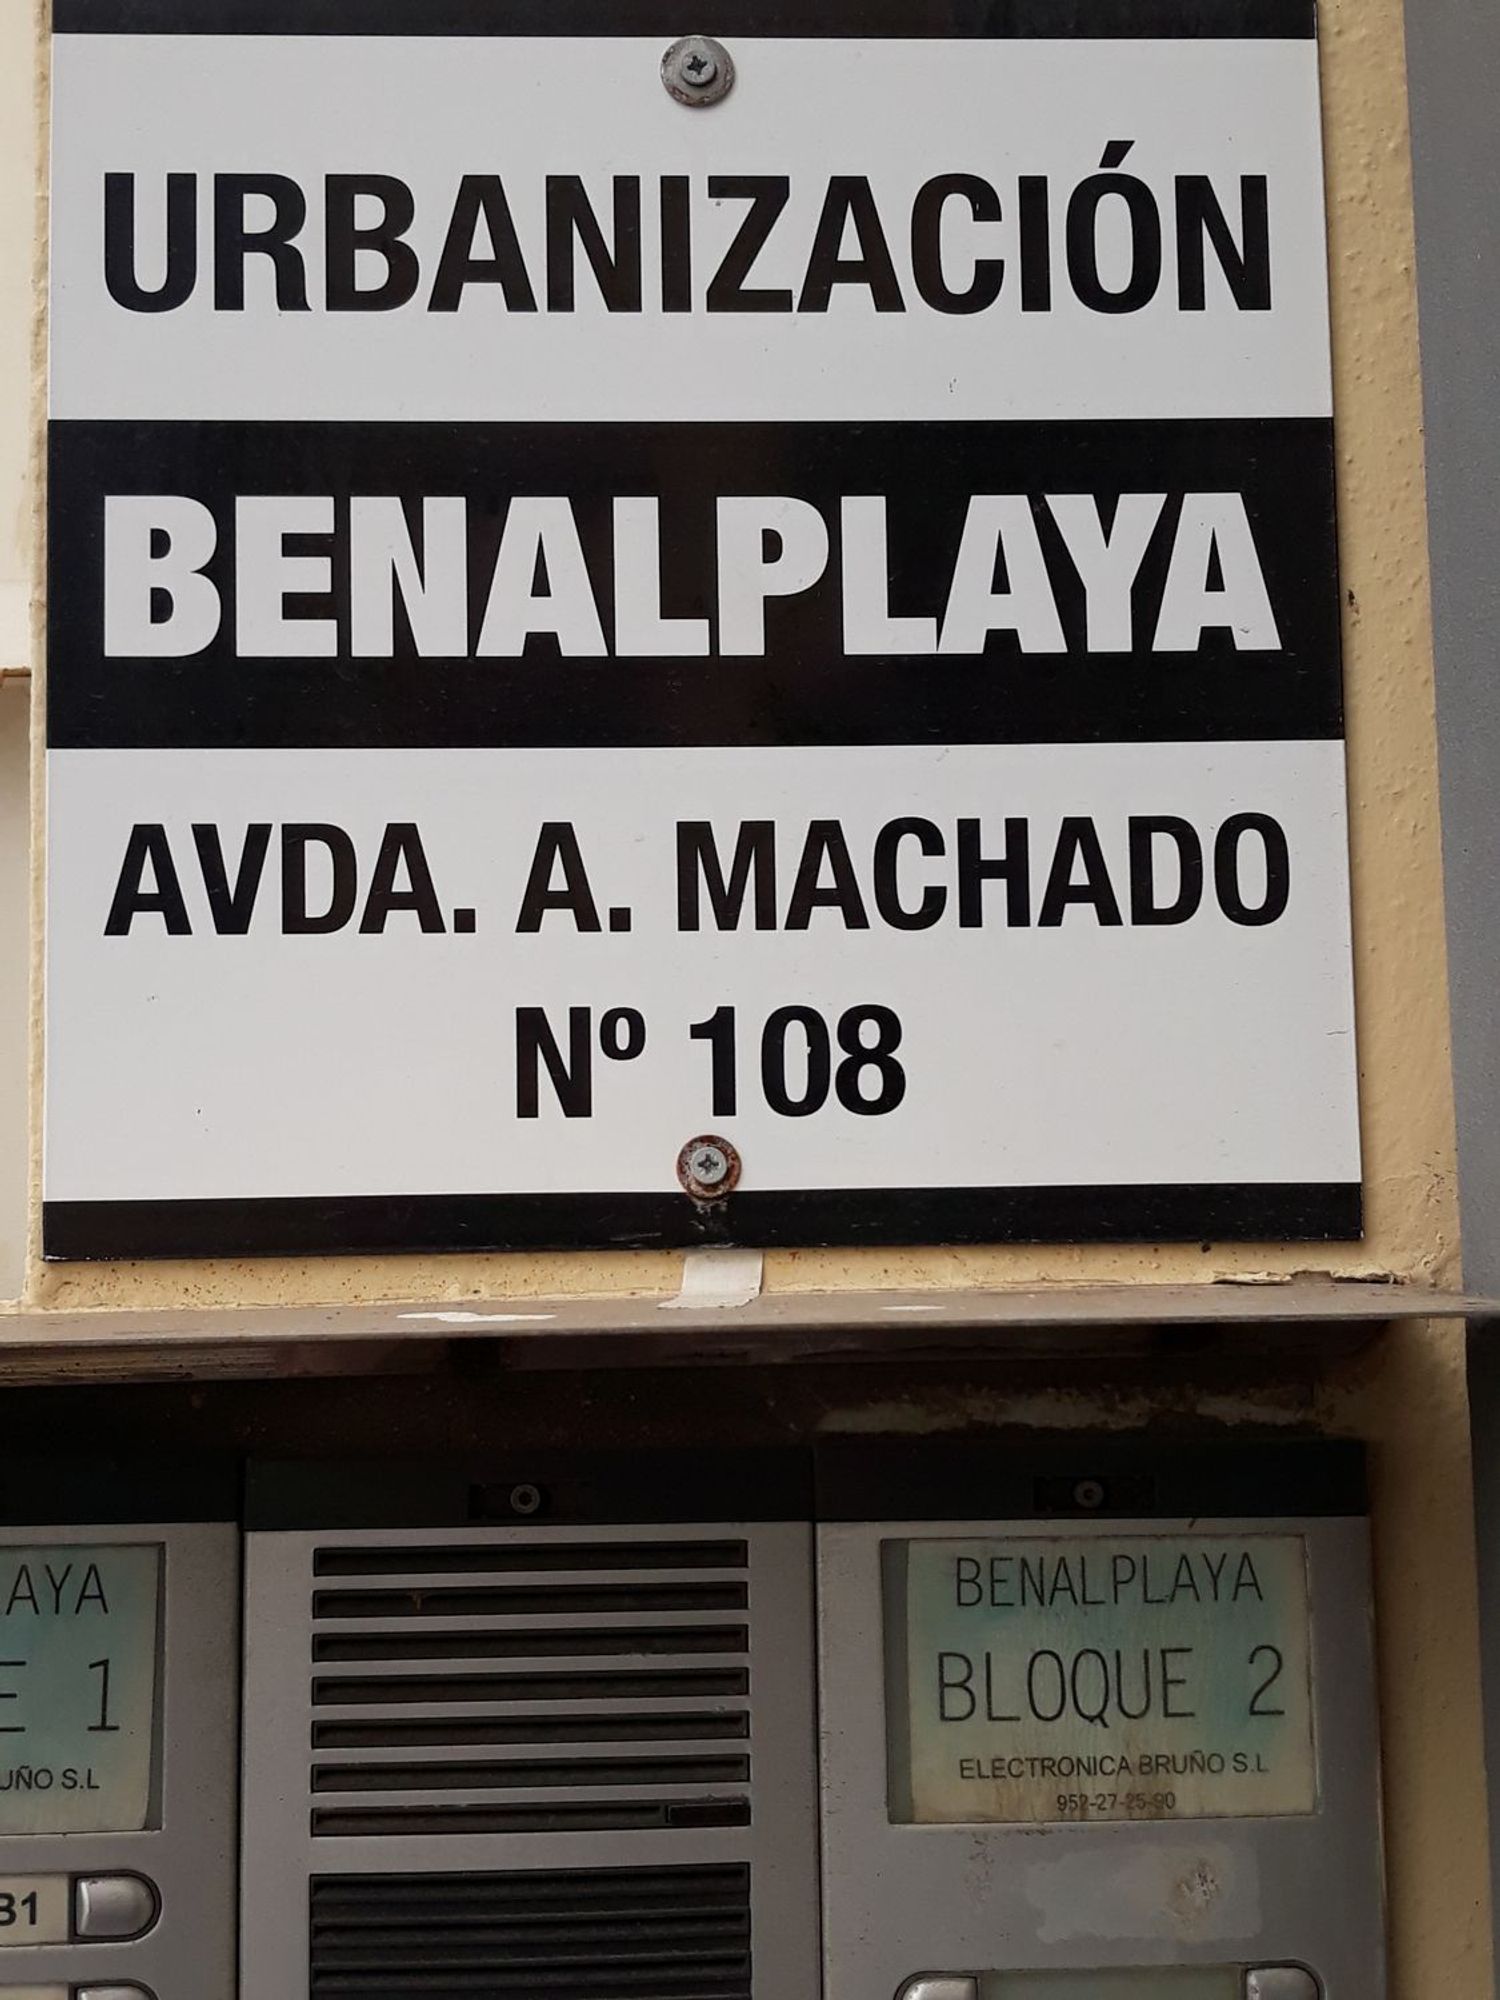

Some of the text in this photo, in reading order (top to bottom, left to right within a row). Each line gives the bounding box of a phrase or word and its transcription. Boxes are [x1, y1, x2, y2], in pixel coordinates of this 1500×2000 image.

[105, 140, 1272, 315] URBANIZACIÓN
[102, 490, 1283, 660] BENALPLAYA
[104, 812, 1290, 936] AVDA. A. MACHADO
[689, 1004, 906, 1118] 108
[5, 1563, 110, 1616] AYA
[956, 1552, 1263, 1607] BENALPLAYA
[87, 1658, 121, 1732] 1
[937, 1644, 1286, 1729] BLOQUE 2
[61, 1768, 101, 1790] S.L
[959, 1750, 1270, 1780] ELECTRONICA BRUÑO S.L
